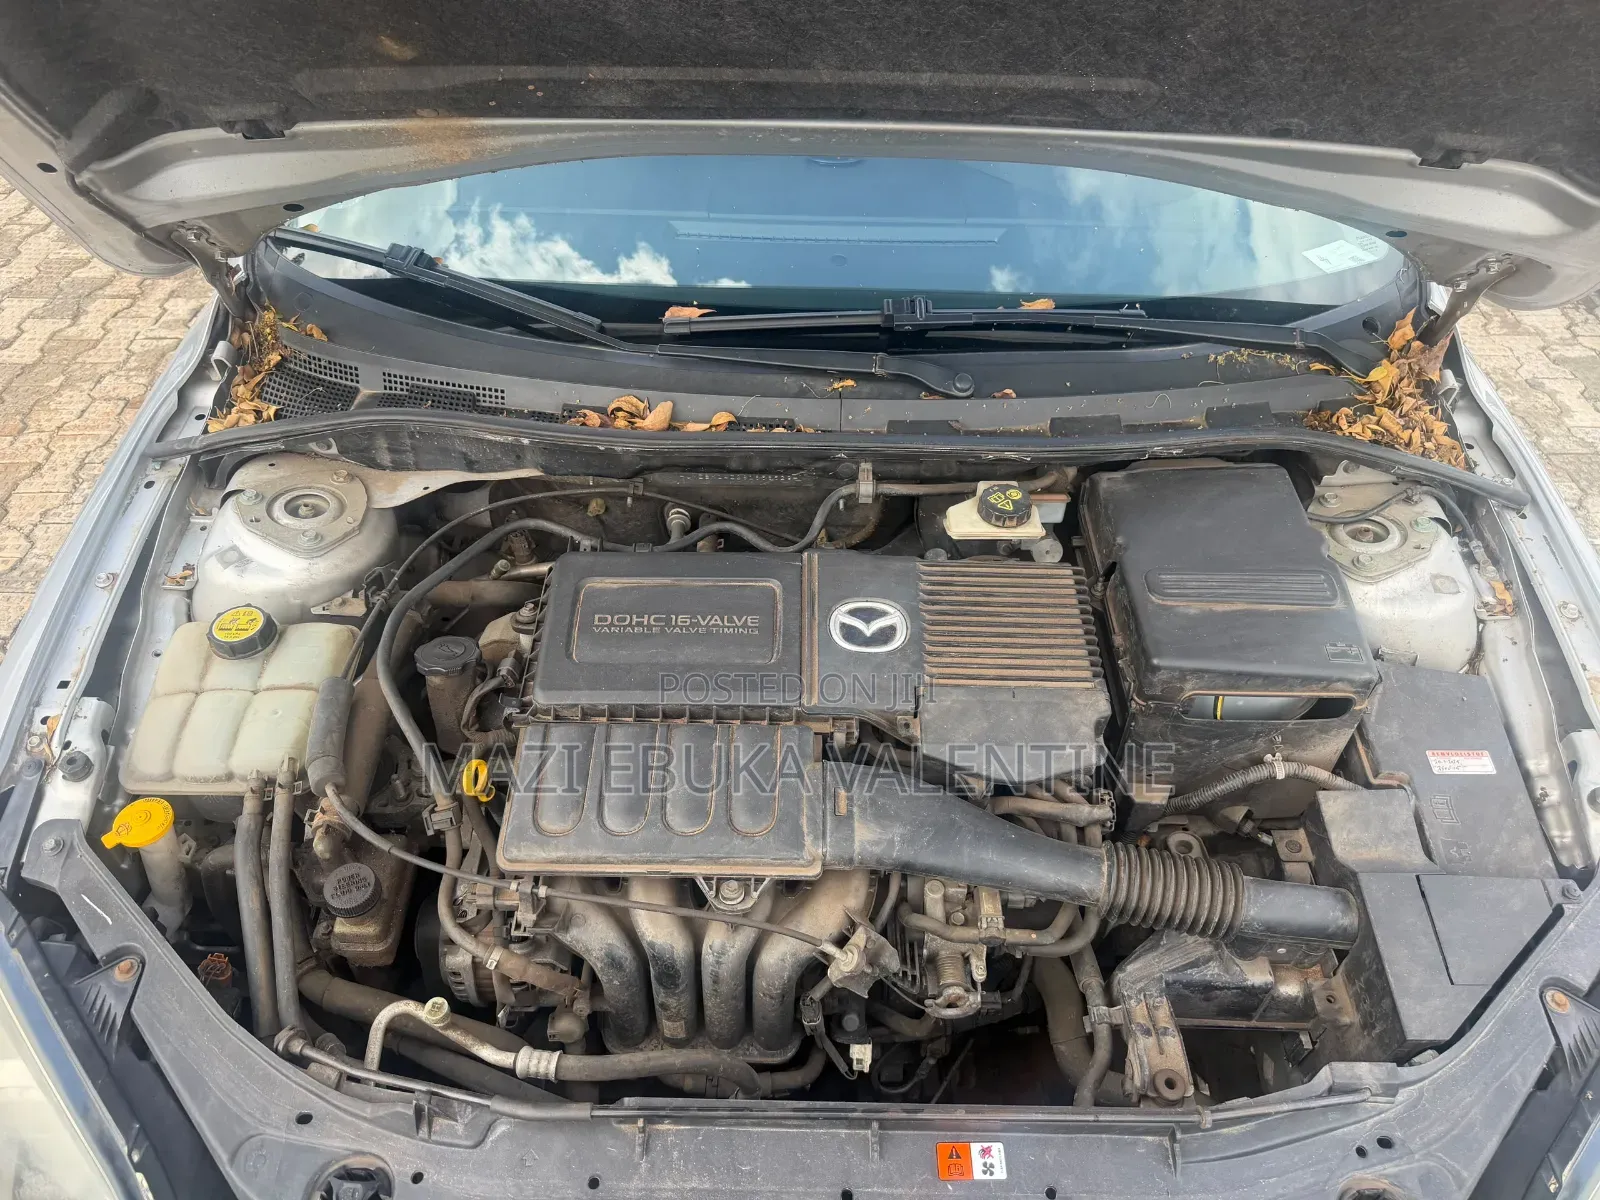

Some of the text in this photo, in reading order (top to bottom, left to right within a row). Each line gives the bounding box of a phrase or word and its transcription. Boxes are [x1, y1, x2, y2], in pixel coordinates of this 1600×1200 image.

[593, 614, 760, 627] DOHC 16-VALVE
[592, 626, 661, 634] VARIABLE
[709, 627, 760, 635] TIMING
